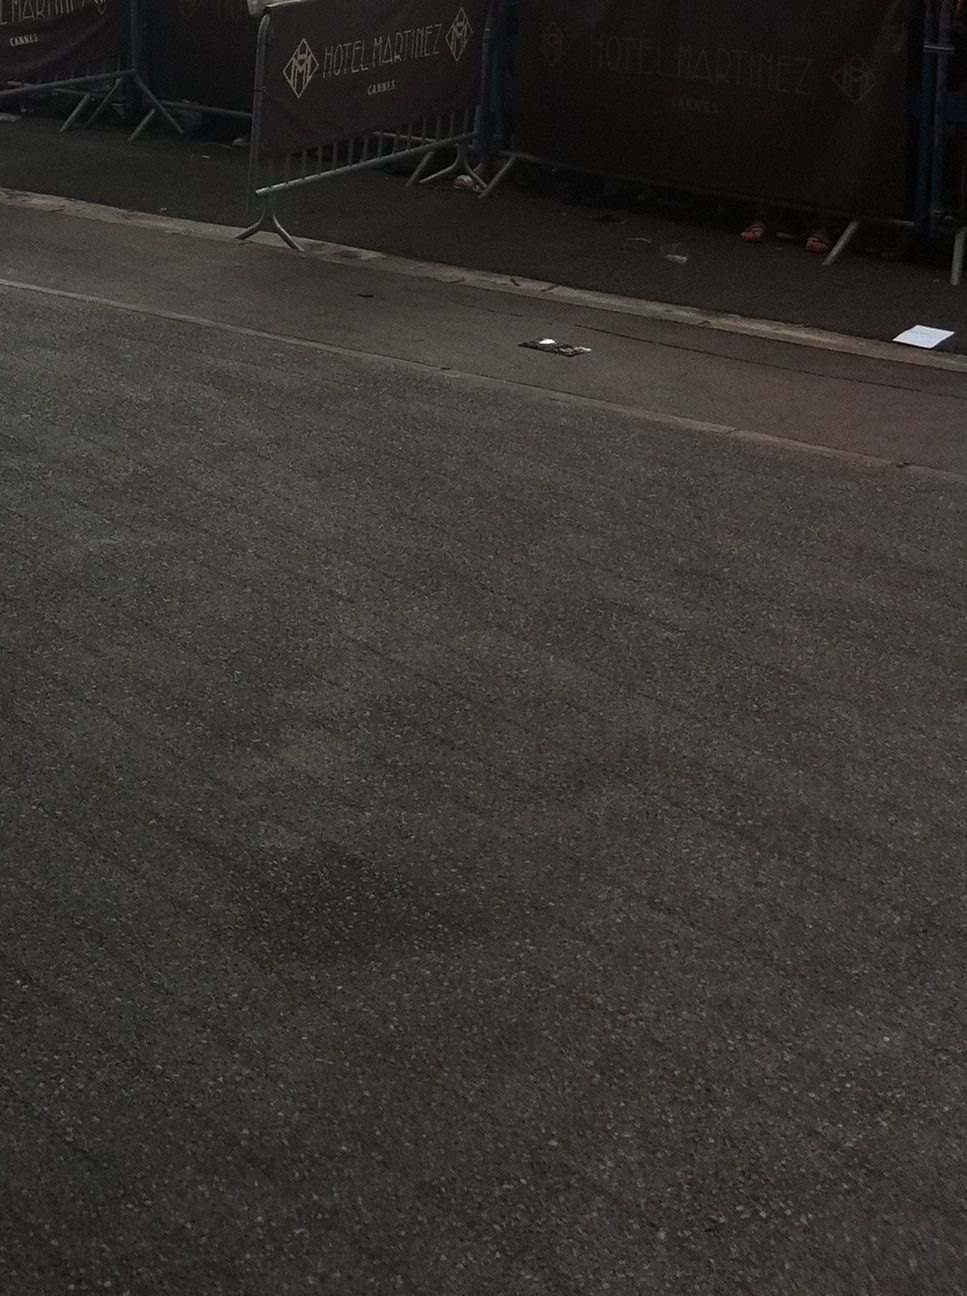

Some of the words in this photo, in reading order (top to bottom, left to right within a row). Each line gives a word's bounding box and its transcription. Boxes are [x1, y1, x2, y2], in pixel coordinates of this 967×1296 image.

[9, 33, 38, 47] CANNES
[322, 39, 369, 79] HOTEL
[372, 23, 443, 68] MARTINEZ
[589, 34, 672, 77] HOTEL
[677, 42, 814, 96] MARTINEZ
[367, 80, 396, 95] CANNES
